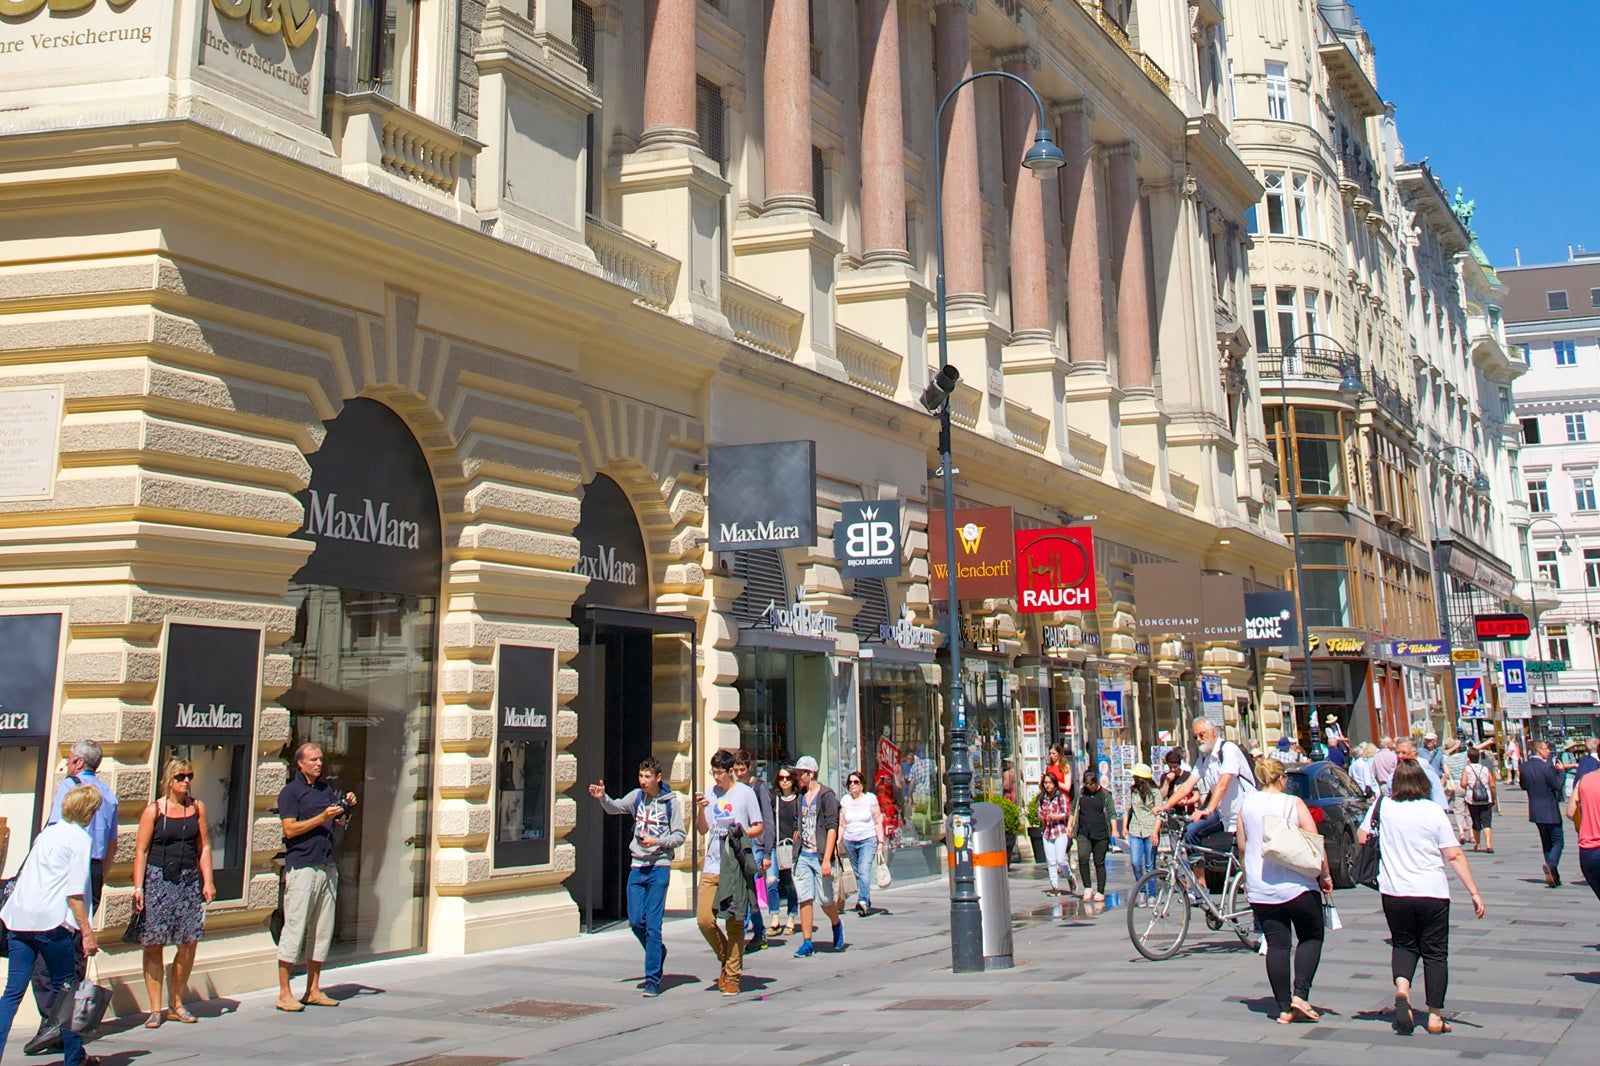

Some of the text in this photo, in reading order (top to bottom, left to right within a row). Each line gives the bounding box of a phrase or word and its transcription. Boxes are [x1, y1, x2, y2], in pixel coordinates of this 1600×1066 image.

[30, 25, 152, 49] Versicherung
[233, 41, 309, 95] Versicherung
[305, 489, 419, 549] MaxMara
[719, 520, 799, 543] MaxMara
[575, 544, 636, 586] axMara
[933, 559, 1012, 580] Wlendorff
[1023, 587, 1090, 607] RAUCH
[1139, 617, 1200, 627] LONGCHAMP
[1204, 626, 1244, 635] GCHAMP
[1245, 616, 1282, 629] MONT
[1246, 627, 1283, 640] BLANC
[1327, 637, 1365, 653] Tchibo
[1408, 644, 1442, 654] Tchibo
[0, 706, 29, 730] ara
[175, 703, 242, 728] MaxMara
[503, 706, 547, 728] MaxMara
